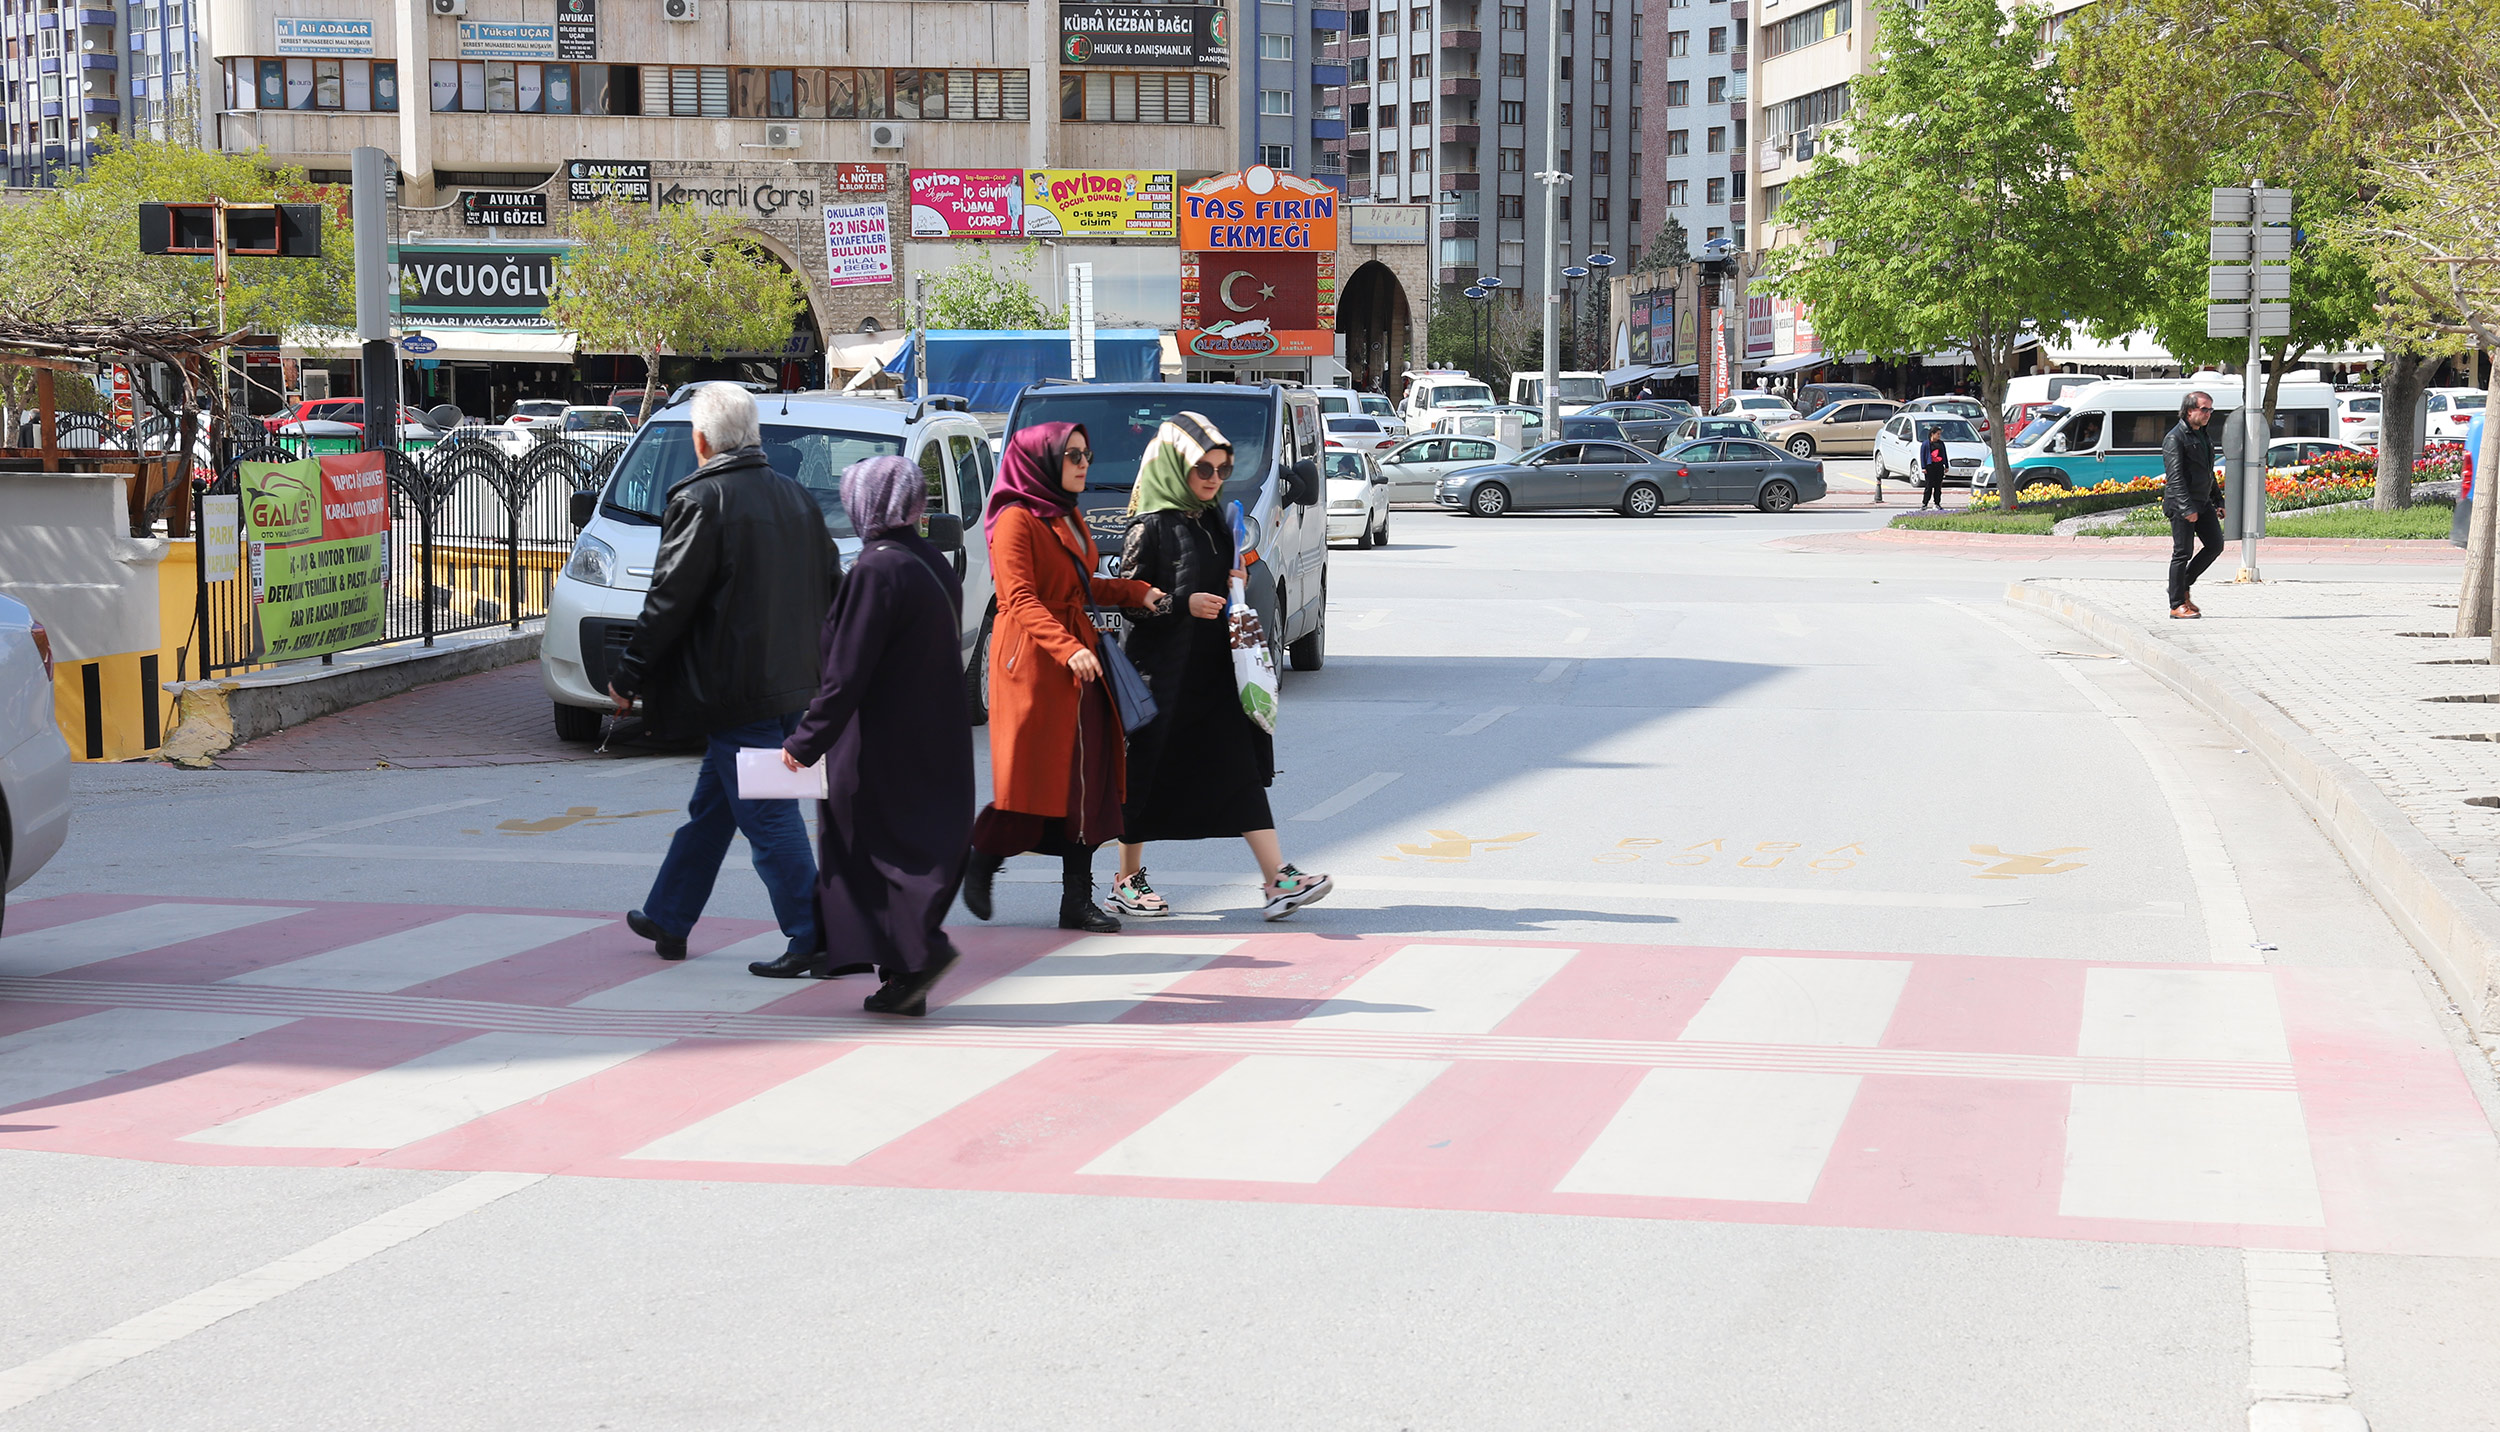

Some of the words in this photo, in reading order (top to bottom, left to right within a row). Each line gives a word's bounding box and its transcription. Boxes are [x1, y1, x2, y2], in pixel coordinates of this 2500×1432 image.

[560, 14, 594, 22] AVUKAT
[1094, 8, 1162, 17] AVUKAT
[300, 24, 316, 33] Ali
[319, 24, 368, 34] ADALAR
[1064, 14, 1104, 31] KÜBRA
[1107, 17, 1154, 32] KEZBAN
[1157, 15, 1193, 33] BAĞCI
[482, 27, 517, 37] Yüksel
[520, 28, 550, 39] UÇAR
[1094, 44, 1124, 54] HUKUK
[1126, 45, 1132, 54] &
[1134, 44, 1192, 58] DANIŞMANLIK
[588, 165, 647, 177] AVUKAT
[854, 165, 869, 173] T.C.
[840, 174, 849, 183] 4.
[851, 174, 884, 183] NOTER
[571, 182, 612, 198] SELÇUK
[963, 184, 975, 199] İÇ
[1051, 172, 1122, 203] AVİDA
[490, 194, 536, 205] AVUKAT
[657, 182, 747, 212] Kemerli
[753, 184, 814, 216] Çarşı
[1059, 197, 1085, 212] ÇOCUK
[1087, 193, 1122, 202] DÜNYASI
[827, 208, 865, 219] OKULLAR
[1186, 196, 1244, 222] TAŞ
[1255, 197, 1333, 219] FIRIN
[482, 211, 499, 223] Ali
[503, 209, 545, 224] GÖZEL
[968, 216, 1006, 228] ÇORAP
[829, 222, 844, 235] 23
[832, 245, 887, 257] BULUNUR
[1196, 340, 1229, 350] ALPER
[331, 474, 356, 490] YAPICI
[325, 503, 353, 520] KAPALI
[209, 525, 234, 545] PARK
[310, 552, 316, 569] &
[318, 548, 344, 568] MOTOR
[305, 572, 337, 597] TEMİZLİK
[339, 575, 345, 591] &
[348, 571, 367, 590] PASTA
[290, 610, 304, 628] FAR
[306, 607, 314, 624] VE
[316, 602, 339, 623] AKSAM
